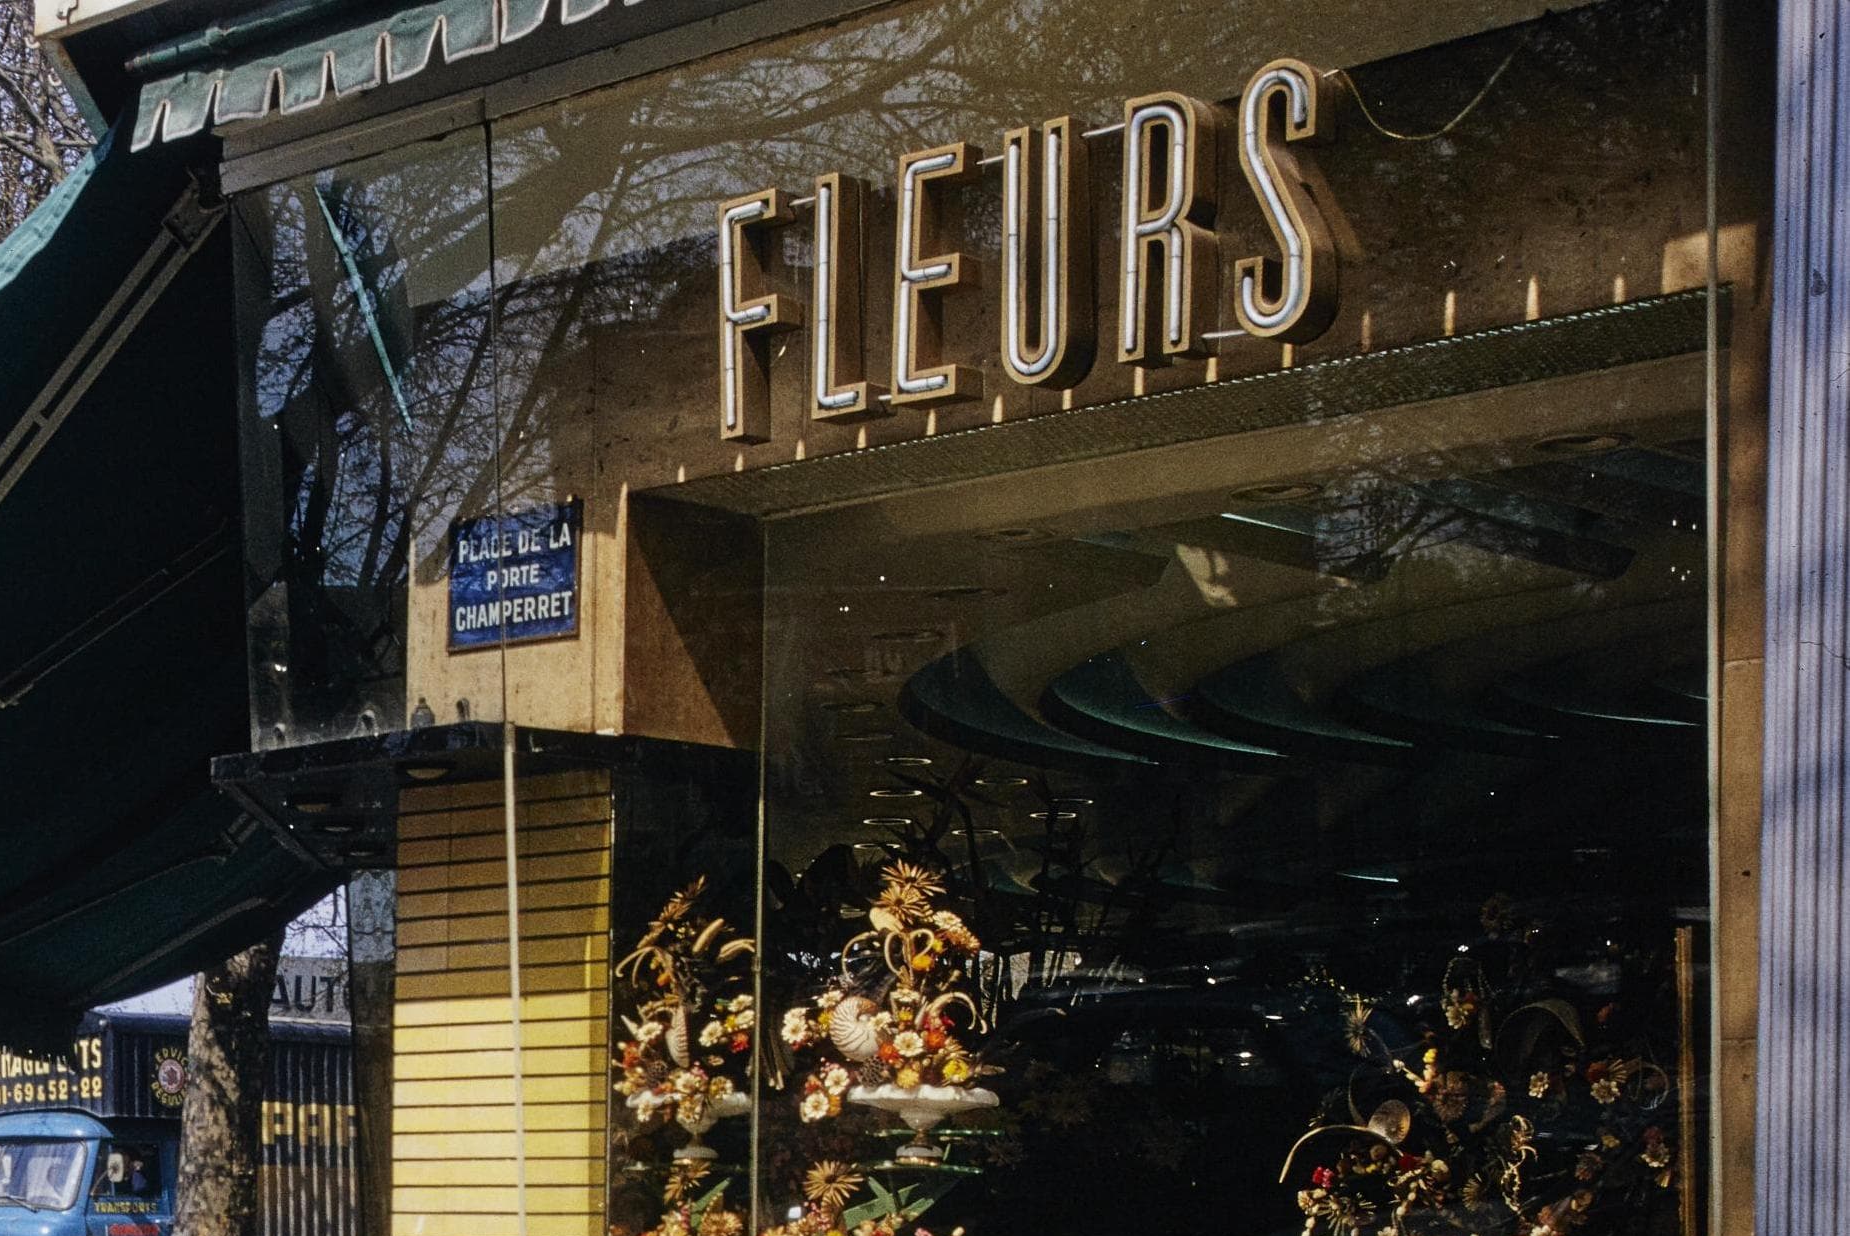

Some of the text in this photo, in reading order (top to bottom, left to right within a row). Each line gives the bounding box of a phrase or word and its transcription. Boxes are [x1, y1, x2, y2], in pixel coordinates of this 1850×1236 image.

[719, 58, 1320, 440] FLEURS
[458, 522, 571, 564] PLACE DE LA
[486, 563, 540, 591] PORTE
[455, 591, 573, 632] CHAMPERRET
